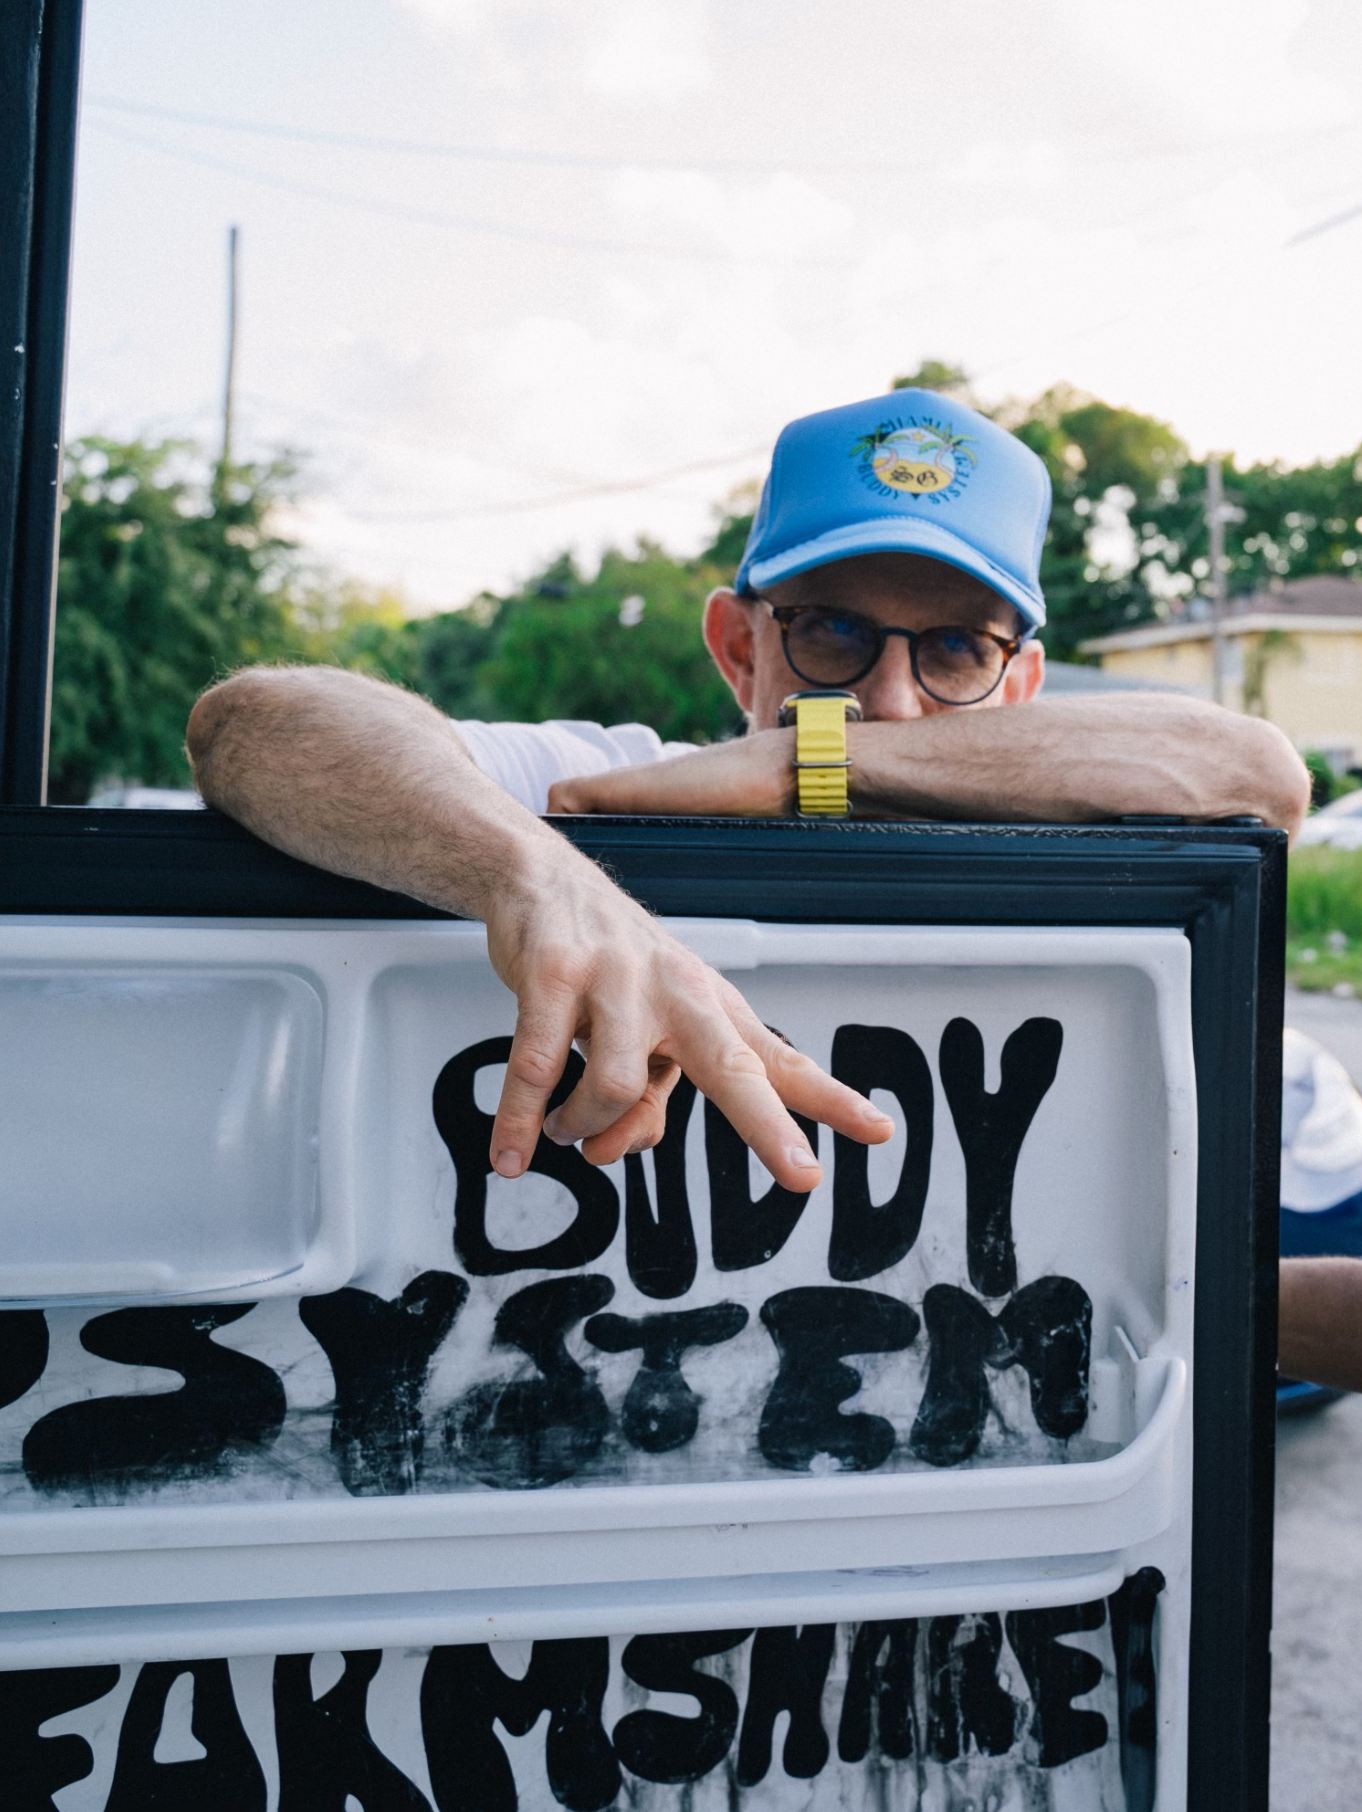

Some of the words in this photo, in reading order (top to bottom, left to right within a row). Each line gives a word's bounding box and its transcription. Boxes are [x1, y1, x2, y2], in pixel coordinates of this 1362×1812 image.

[858, 463, 899, 500] BUDDY
[927, 456, 970, 505] SYSTEM
[432, 1017, 1063, 1298] BUDDY
